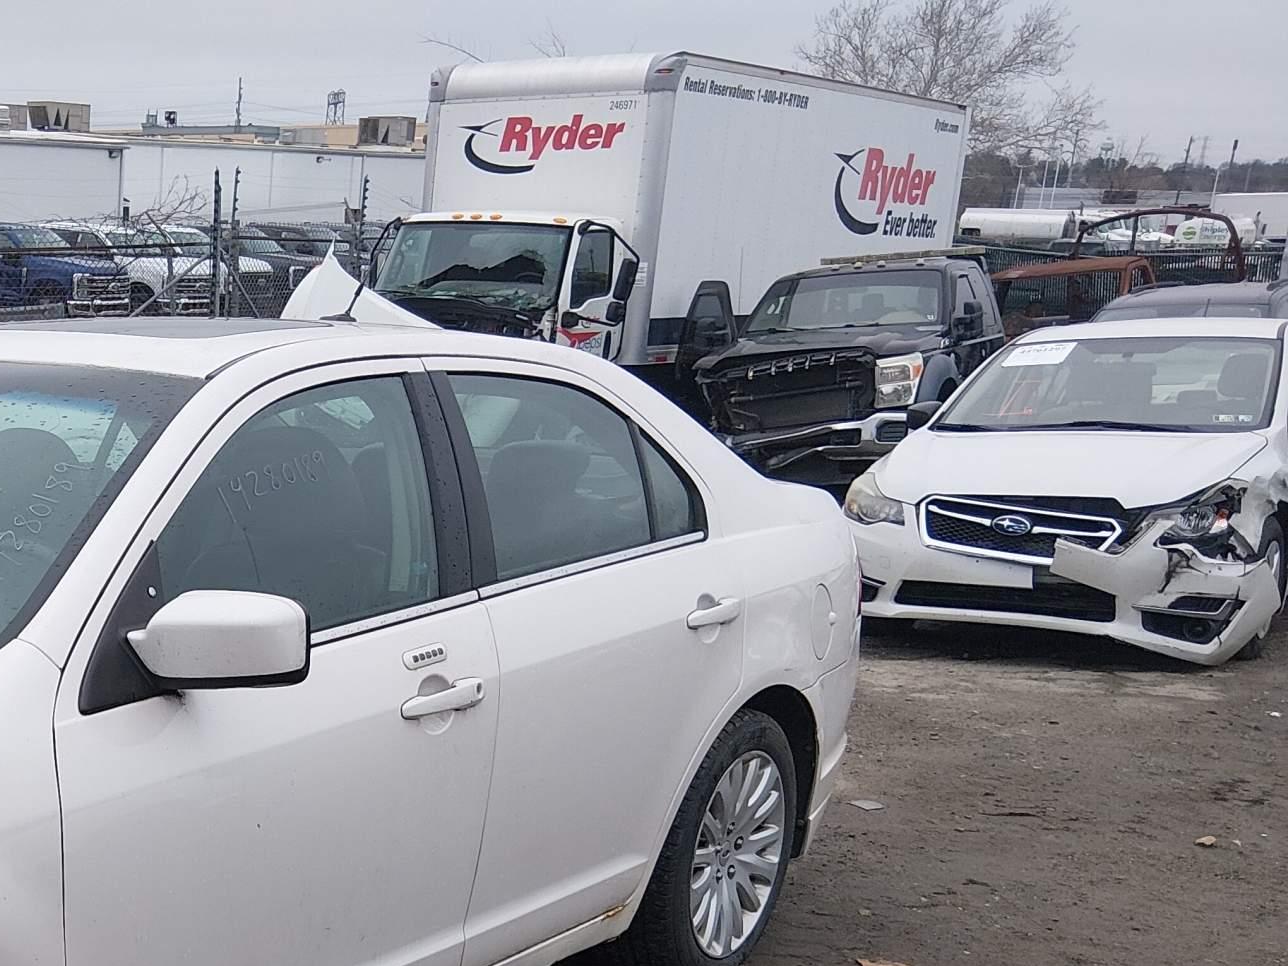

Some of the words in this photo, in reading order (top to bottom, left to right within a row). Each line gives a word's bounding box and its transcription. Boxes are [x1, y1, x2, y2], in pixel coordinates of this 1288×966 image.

[609, 100, 637, 111] 246971
[684, 76, 708, 93] Rental
[708, 80, 756, 101] Reservations:
[756, 87, 810, 109] 1-800-BY-RYDER
[499, 114, 626, 160] Ryder
[857, 147, 937, 216] Ryder
[882, 210, 908, 237] Ever
[905, 211, 938, 239] better.
[217, 450, 327, 524] 14280189
